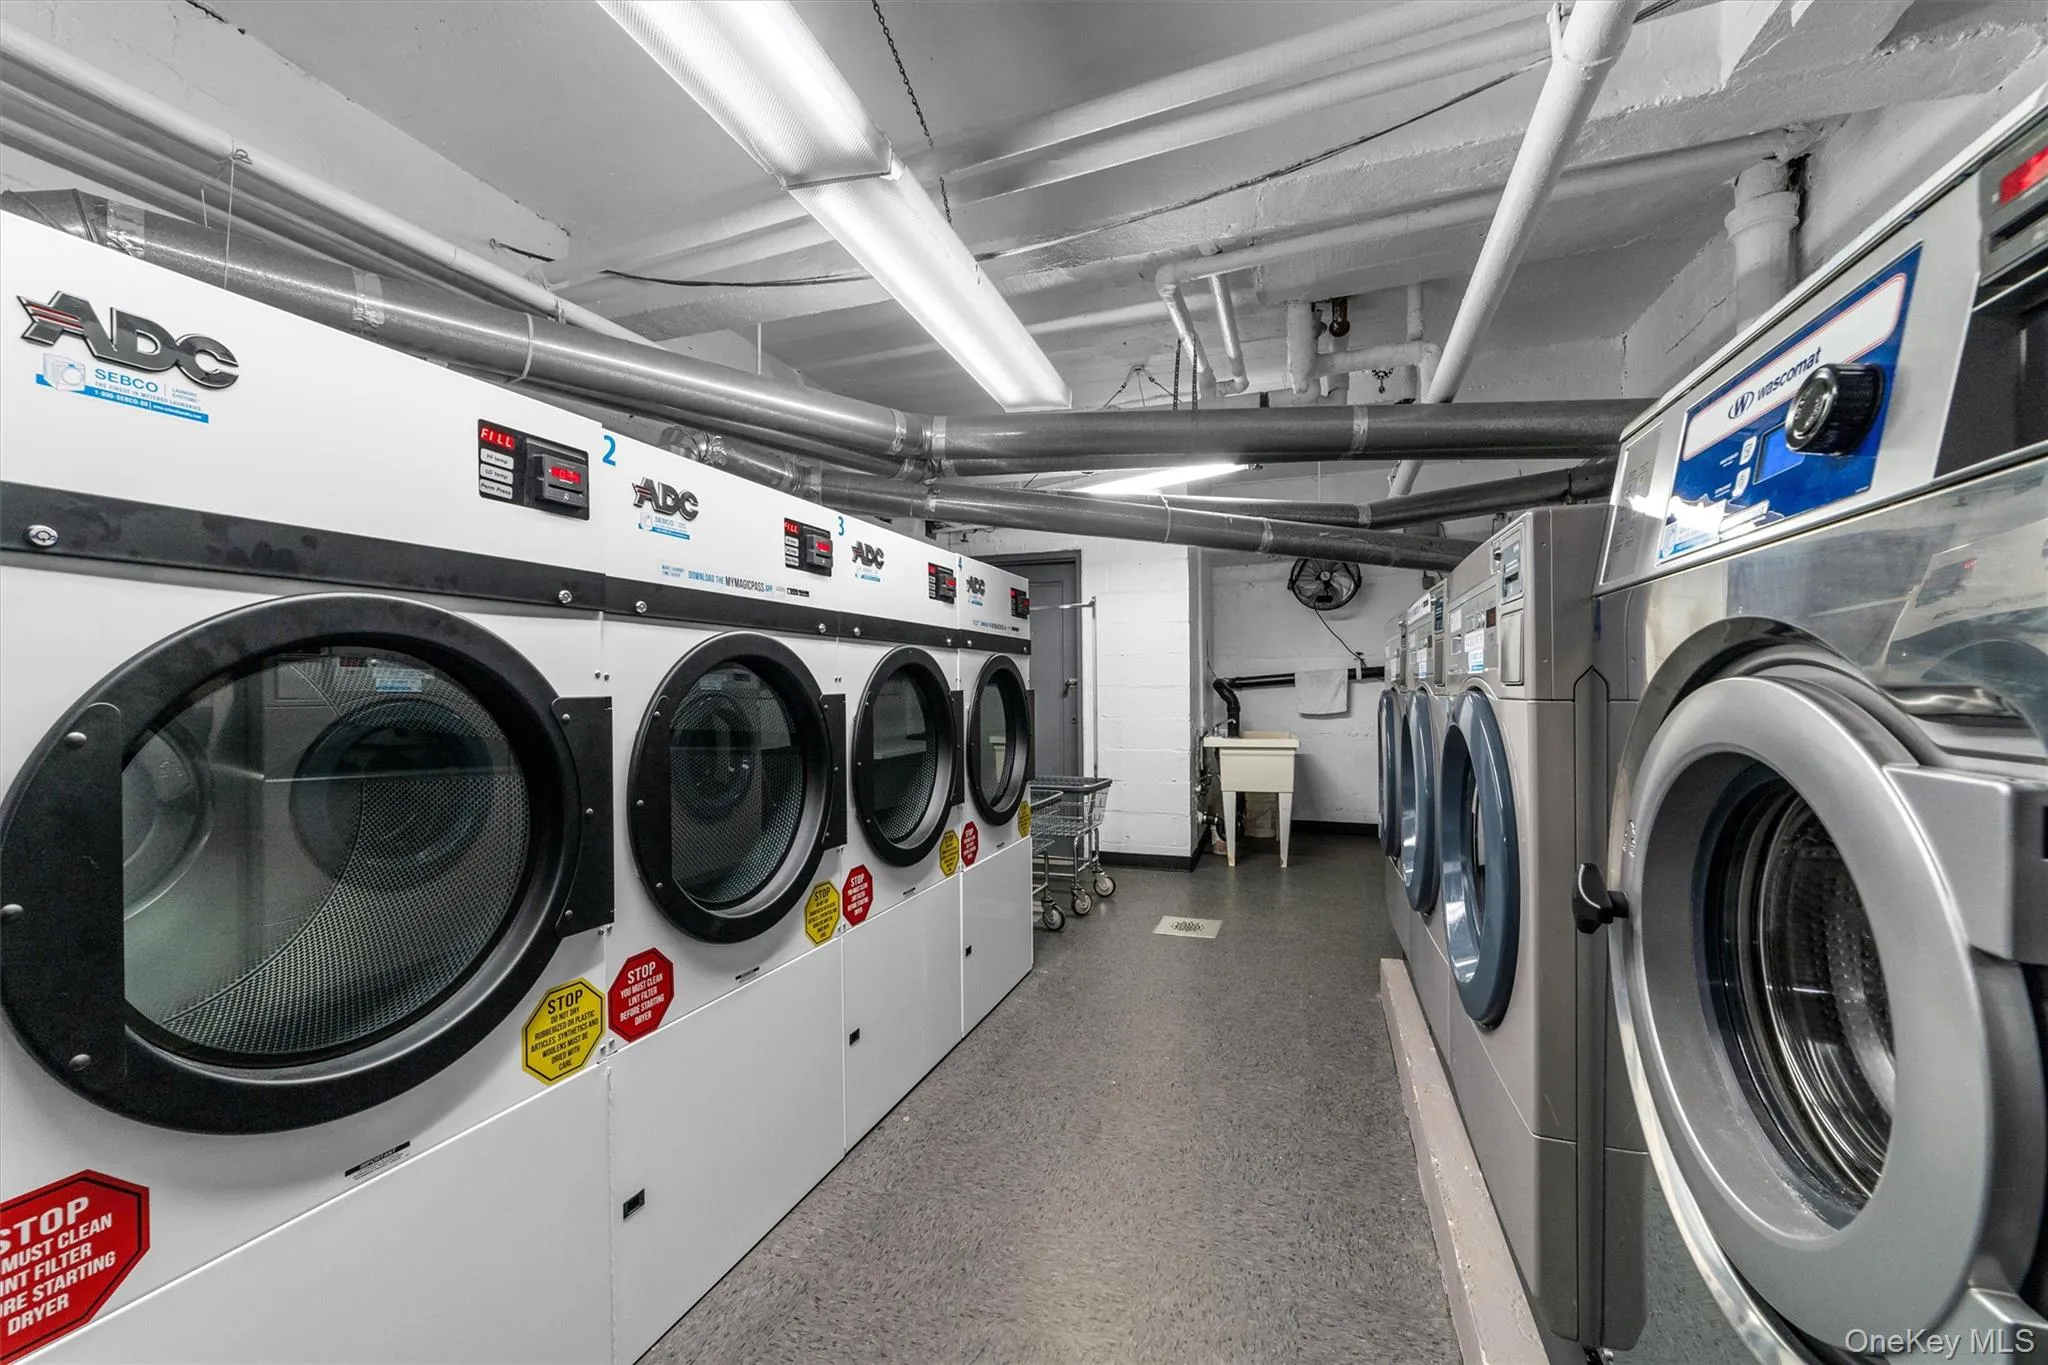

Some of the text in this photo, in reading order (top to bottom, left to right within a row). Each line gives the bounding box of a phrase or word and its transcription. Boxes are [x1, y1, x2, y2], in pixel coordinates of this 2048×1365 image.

[16, 290, 240, 389] ADC
[95, 368, 158, 392] SEBCO
[1758, 346, 1821, 400] wascomat
[481, 428, 512, 448] FILL
[602, 434, 616, 466] 2
[632, 477, 698, 521] ADC
[838, 516, 845, 536] 3
[851, 540, 884, 570] ADC
[725, 576, 764, 592] MYMAGICPASS
[851, 873, 864, 887] STOP
[815, 887, 831, 901] STOP
[628, 961, 656, 984] STOP
[632, 980, 647, 994] MUST
[548, 989, 583, 1014] STOP
[559, 1010, 569, 1020] NOT
[575, 1009, 595, 1023] PLASTIC
[1, 1213, 113, 1275] MUST CLEAN
[34, 1242, 92, 1281] FILTER
[32, 1251, 116, 1302] STARTING
[8, 1293, 69, 1336] DRYER
